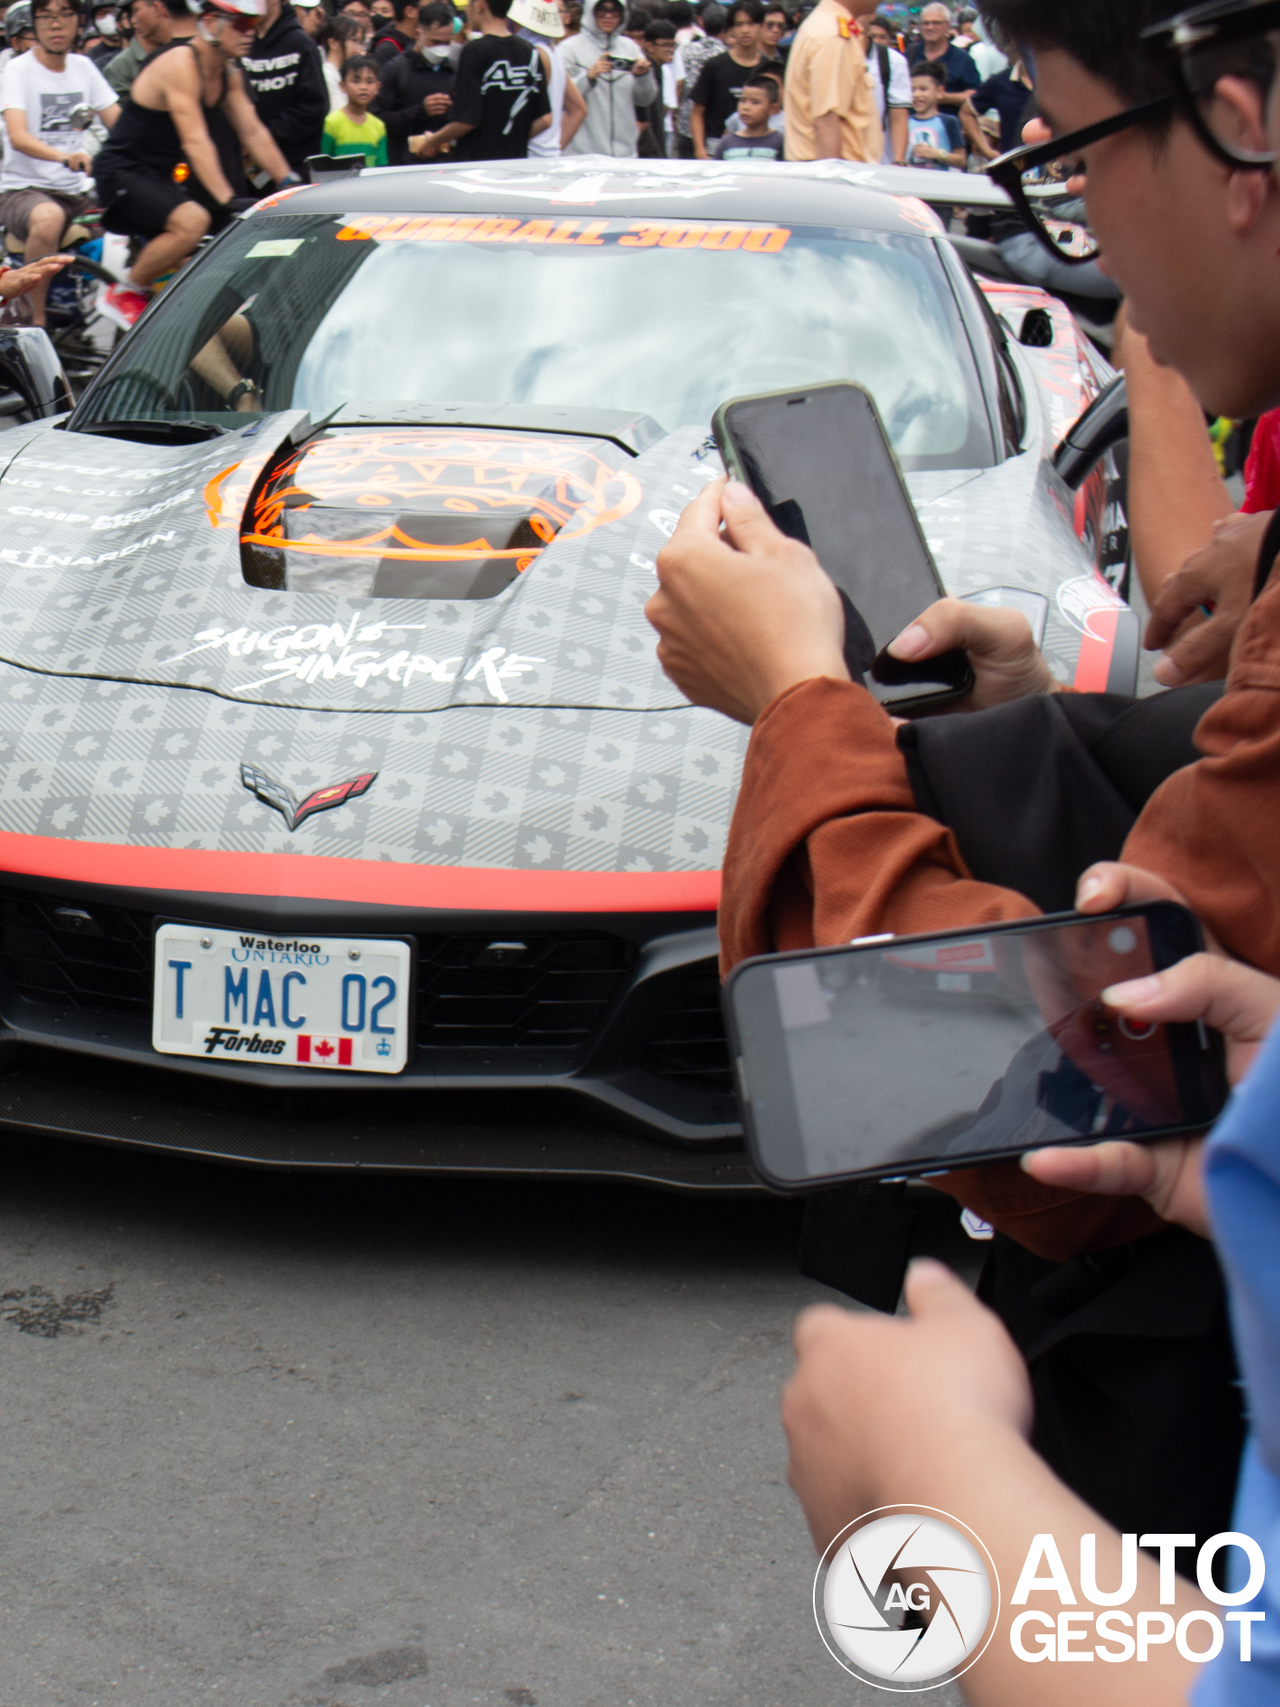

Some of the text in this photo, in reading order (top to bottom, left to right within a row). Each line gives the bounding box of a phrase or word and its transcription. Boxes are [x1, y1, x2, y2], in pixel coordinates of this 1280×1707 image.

[335, 216, 791, 254] GUMBALL 3000
[52, 484, 73, 494] &
[7, 506, 90, 523] CHIP
[47, 530, 176, 567] NARDIN
[158, 611, 361, 666] SAIGON
[232, 646, 547, 703] SINGAPORE
[231, 948, 330, 969] ONTARIO
[239, 936, 321, 954] Waterloo
[168, 959, 192, 1019] T
[224, 964, 307, 1029] MAC
[203, 1026, 287, 1055] Forbes
